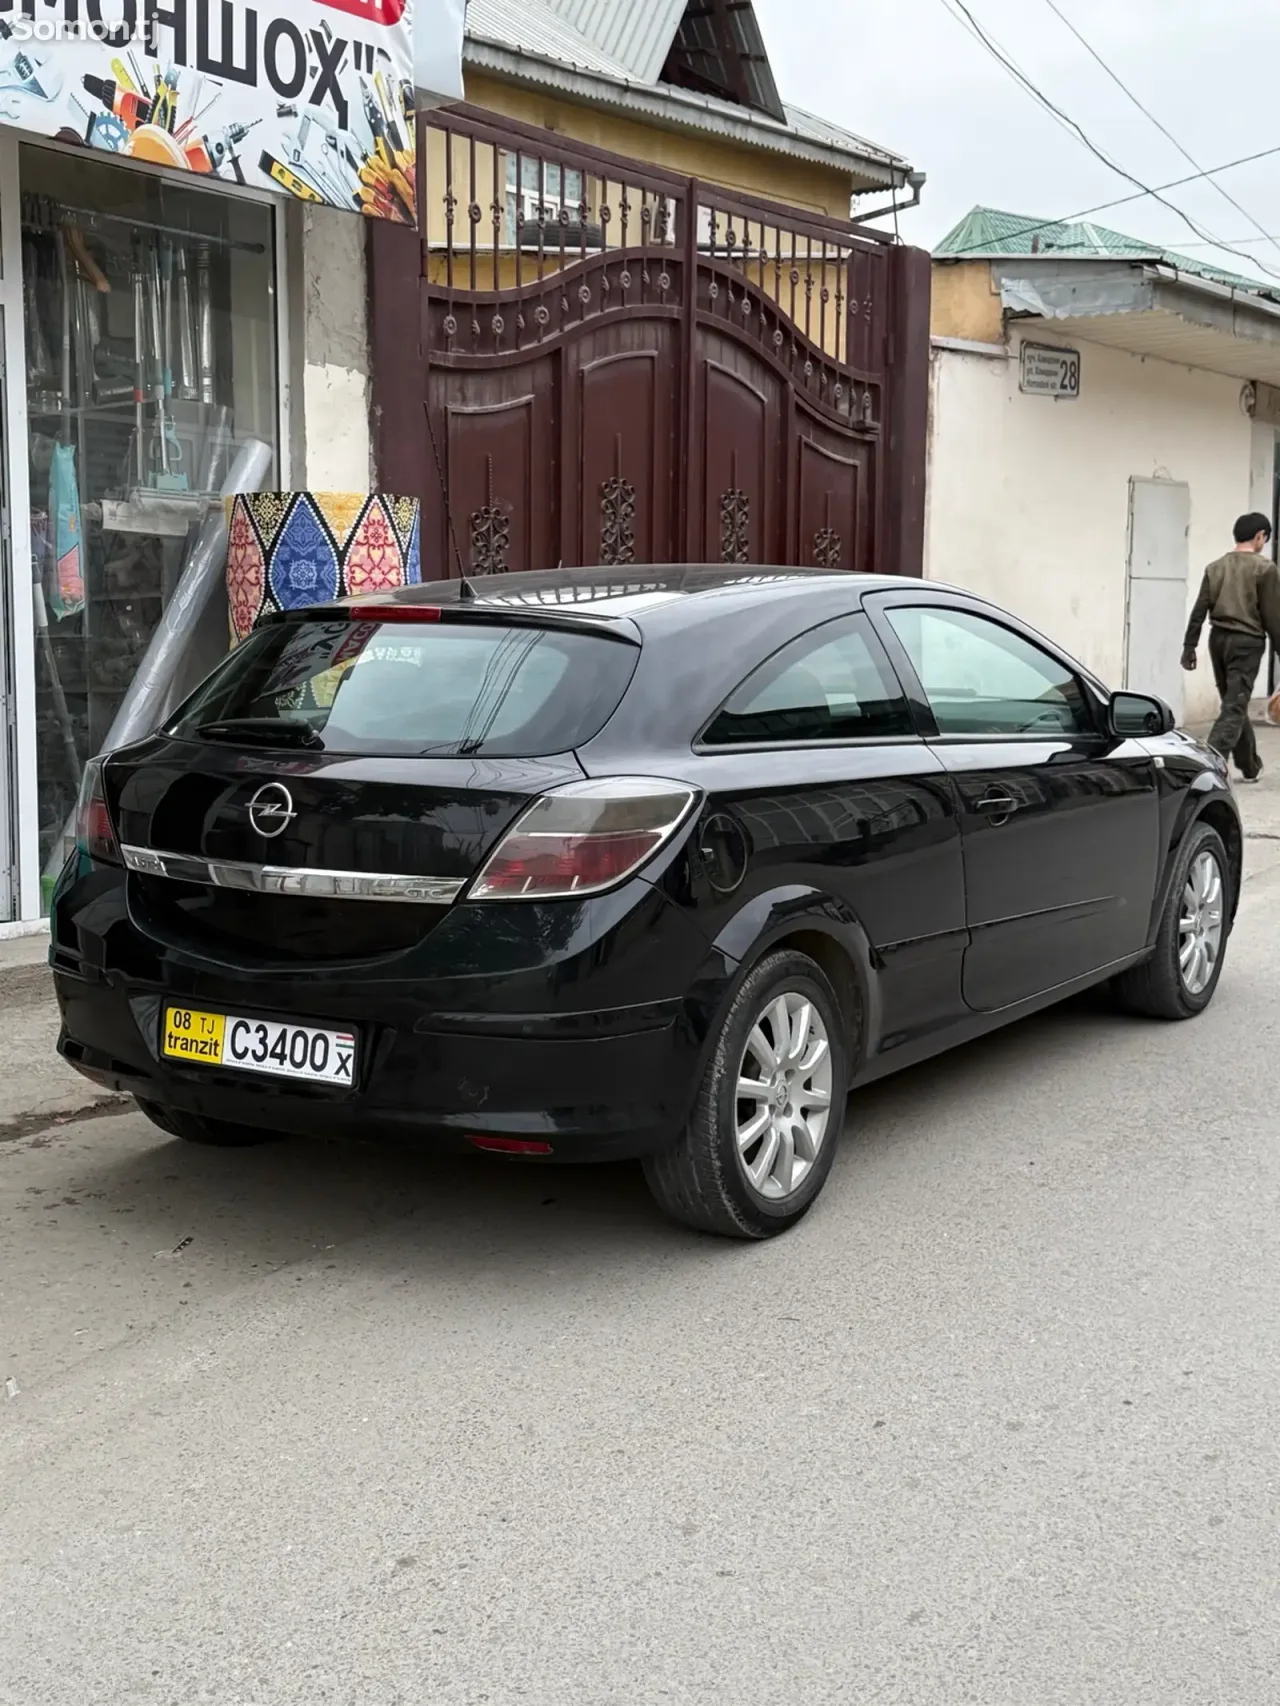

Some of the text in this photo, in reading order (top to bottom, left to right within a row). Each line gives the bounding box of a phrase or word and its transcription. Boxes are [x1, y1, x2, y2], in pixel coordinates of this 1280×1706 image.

[1060, 360, 1077, 391] 28
[404, 887, 443, 899] GTC
[173, 1010, 215, 1034] 08 TJ
[167, 1031, 220, 1057] tranzit
[230, 1020, 330, 1073] C3400
